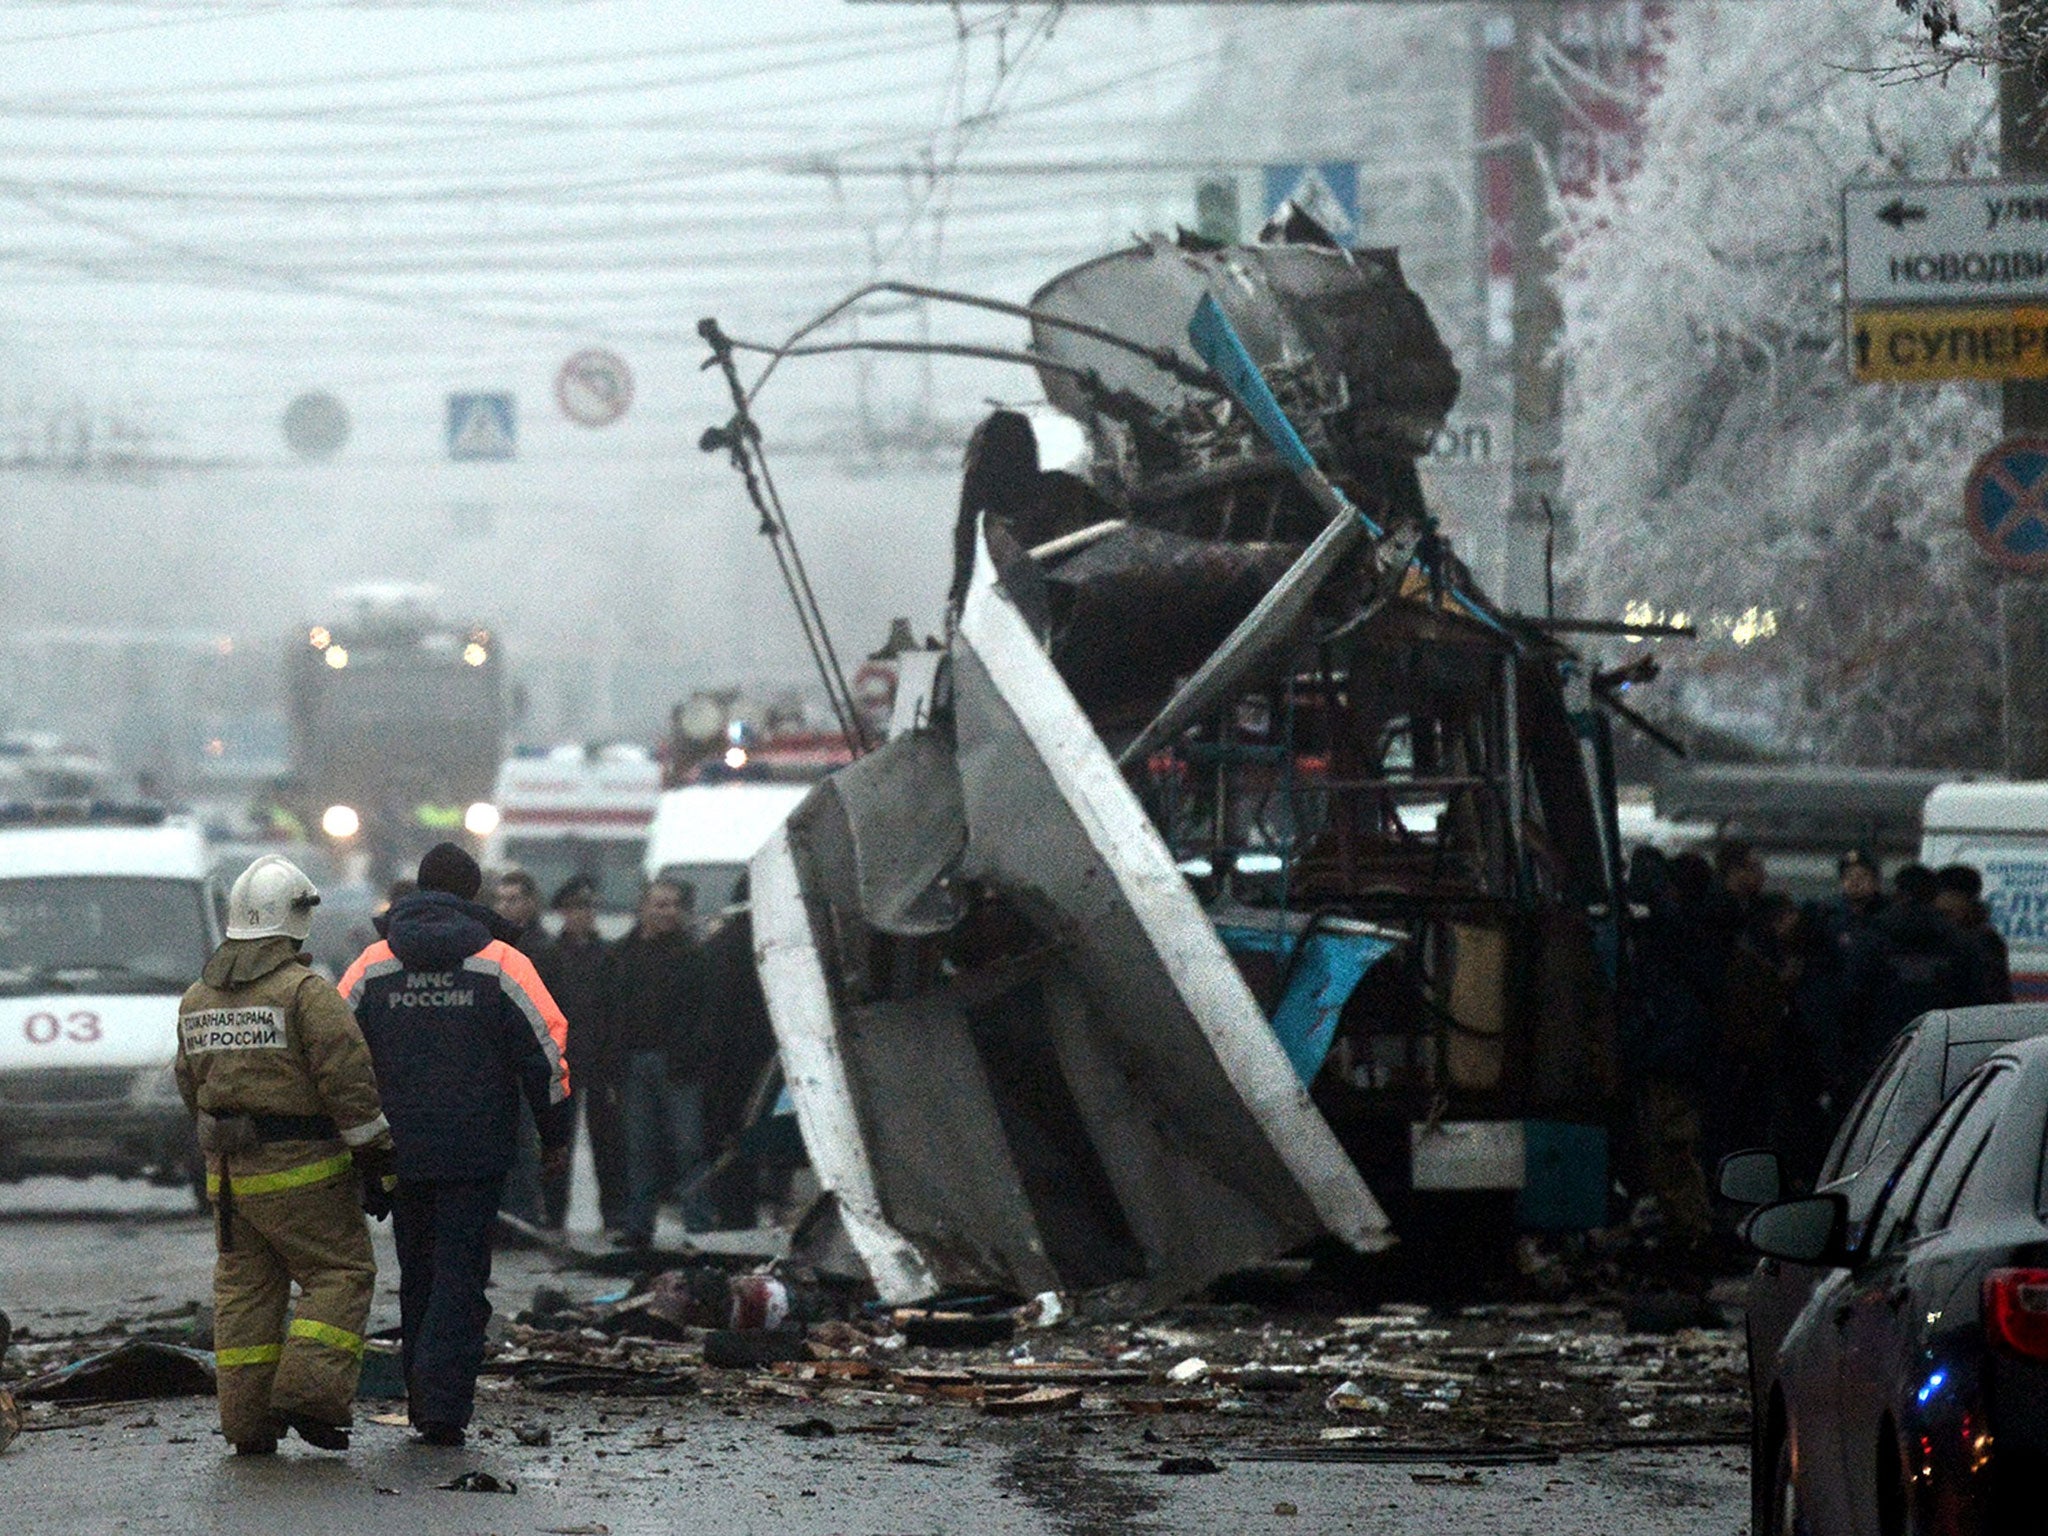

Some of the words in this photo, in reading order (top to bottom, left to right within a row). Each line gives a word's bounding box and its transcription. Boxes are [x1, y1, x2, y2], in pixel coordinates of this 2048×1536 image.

[1888, 325, 2048, 366] СУПЕР
[406, 972, 454, 988] МЧС
[388, 989, 475, 1009] РОССИИ
[24, 1010, 103, 1043] 03
[210, 1030, 277, 1046] РОССИИ
